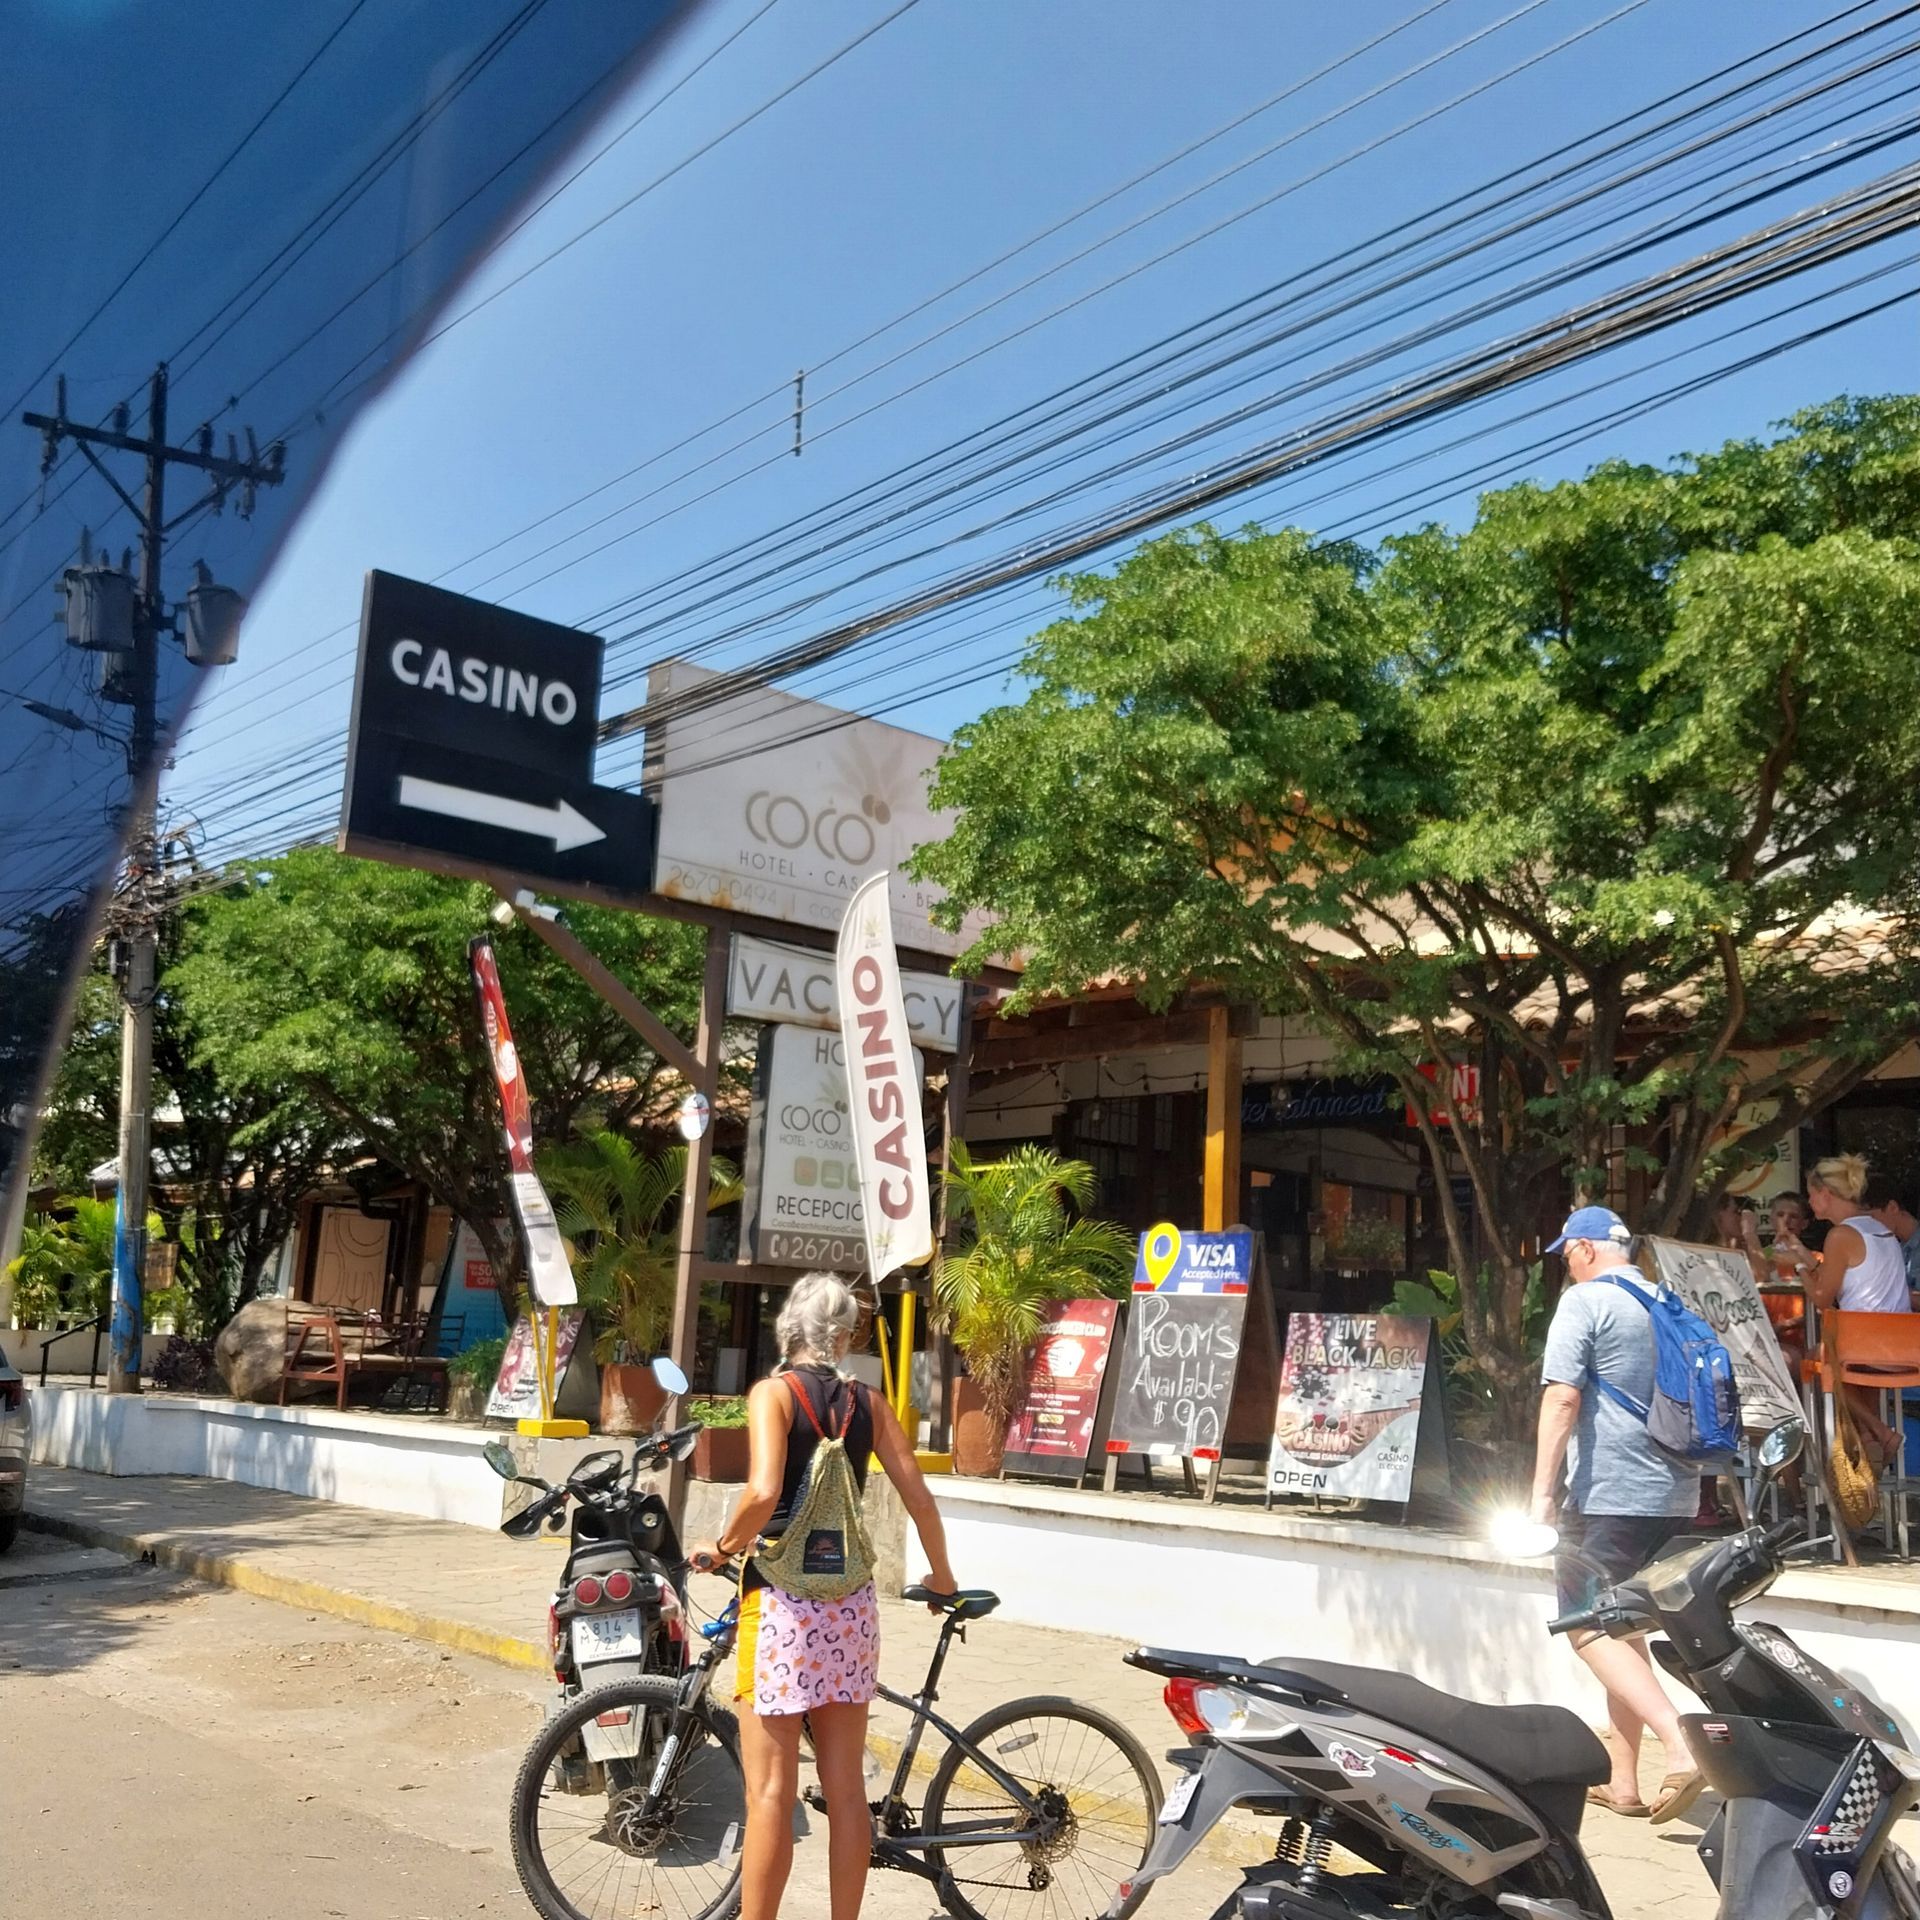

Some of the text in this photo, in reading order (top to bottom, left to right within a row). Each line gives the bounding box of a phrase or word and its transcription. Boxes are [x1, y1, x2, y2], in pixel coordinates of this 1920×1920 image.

[391, 639, 577, 726] CASINO
[745, 790, 876, 866] COCO
[739, 850, 797, 878] HOTEL
[740, 958, 957, 1035] VACCY
[852, 955, 914, 1221] CASINO
[781, 1104, 841, 1135] COCO
[779, 1133, 850, 1152] HOTEL CASINO
[777, 1195, 864, 1221] RECEPCIÓ
[791, 1236, 866, 1264] 2670-0
[1186, 1244, 1236, 1267] VISA
[1182, 1269, 1240, 1279] Accepted Here
[1334, 1319, 1377, 1340] LIVE
[1291, 1345, 1418, 1370] BLACK JACK
[1130, 1355, 1223, 1400] Available
[1292, 1430, 1351, 1453] CASINO
[1377, 1452, 1409, 1463] CASINO
[1274, 1470, 1327, 1488] OPEN
[593, 1619, 622, 1636] 814
[594, 1635, 622, 1652] 727
